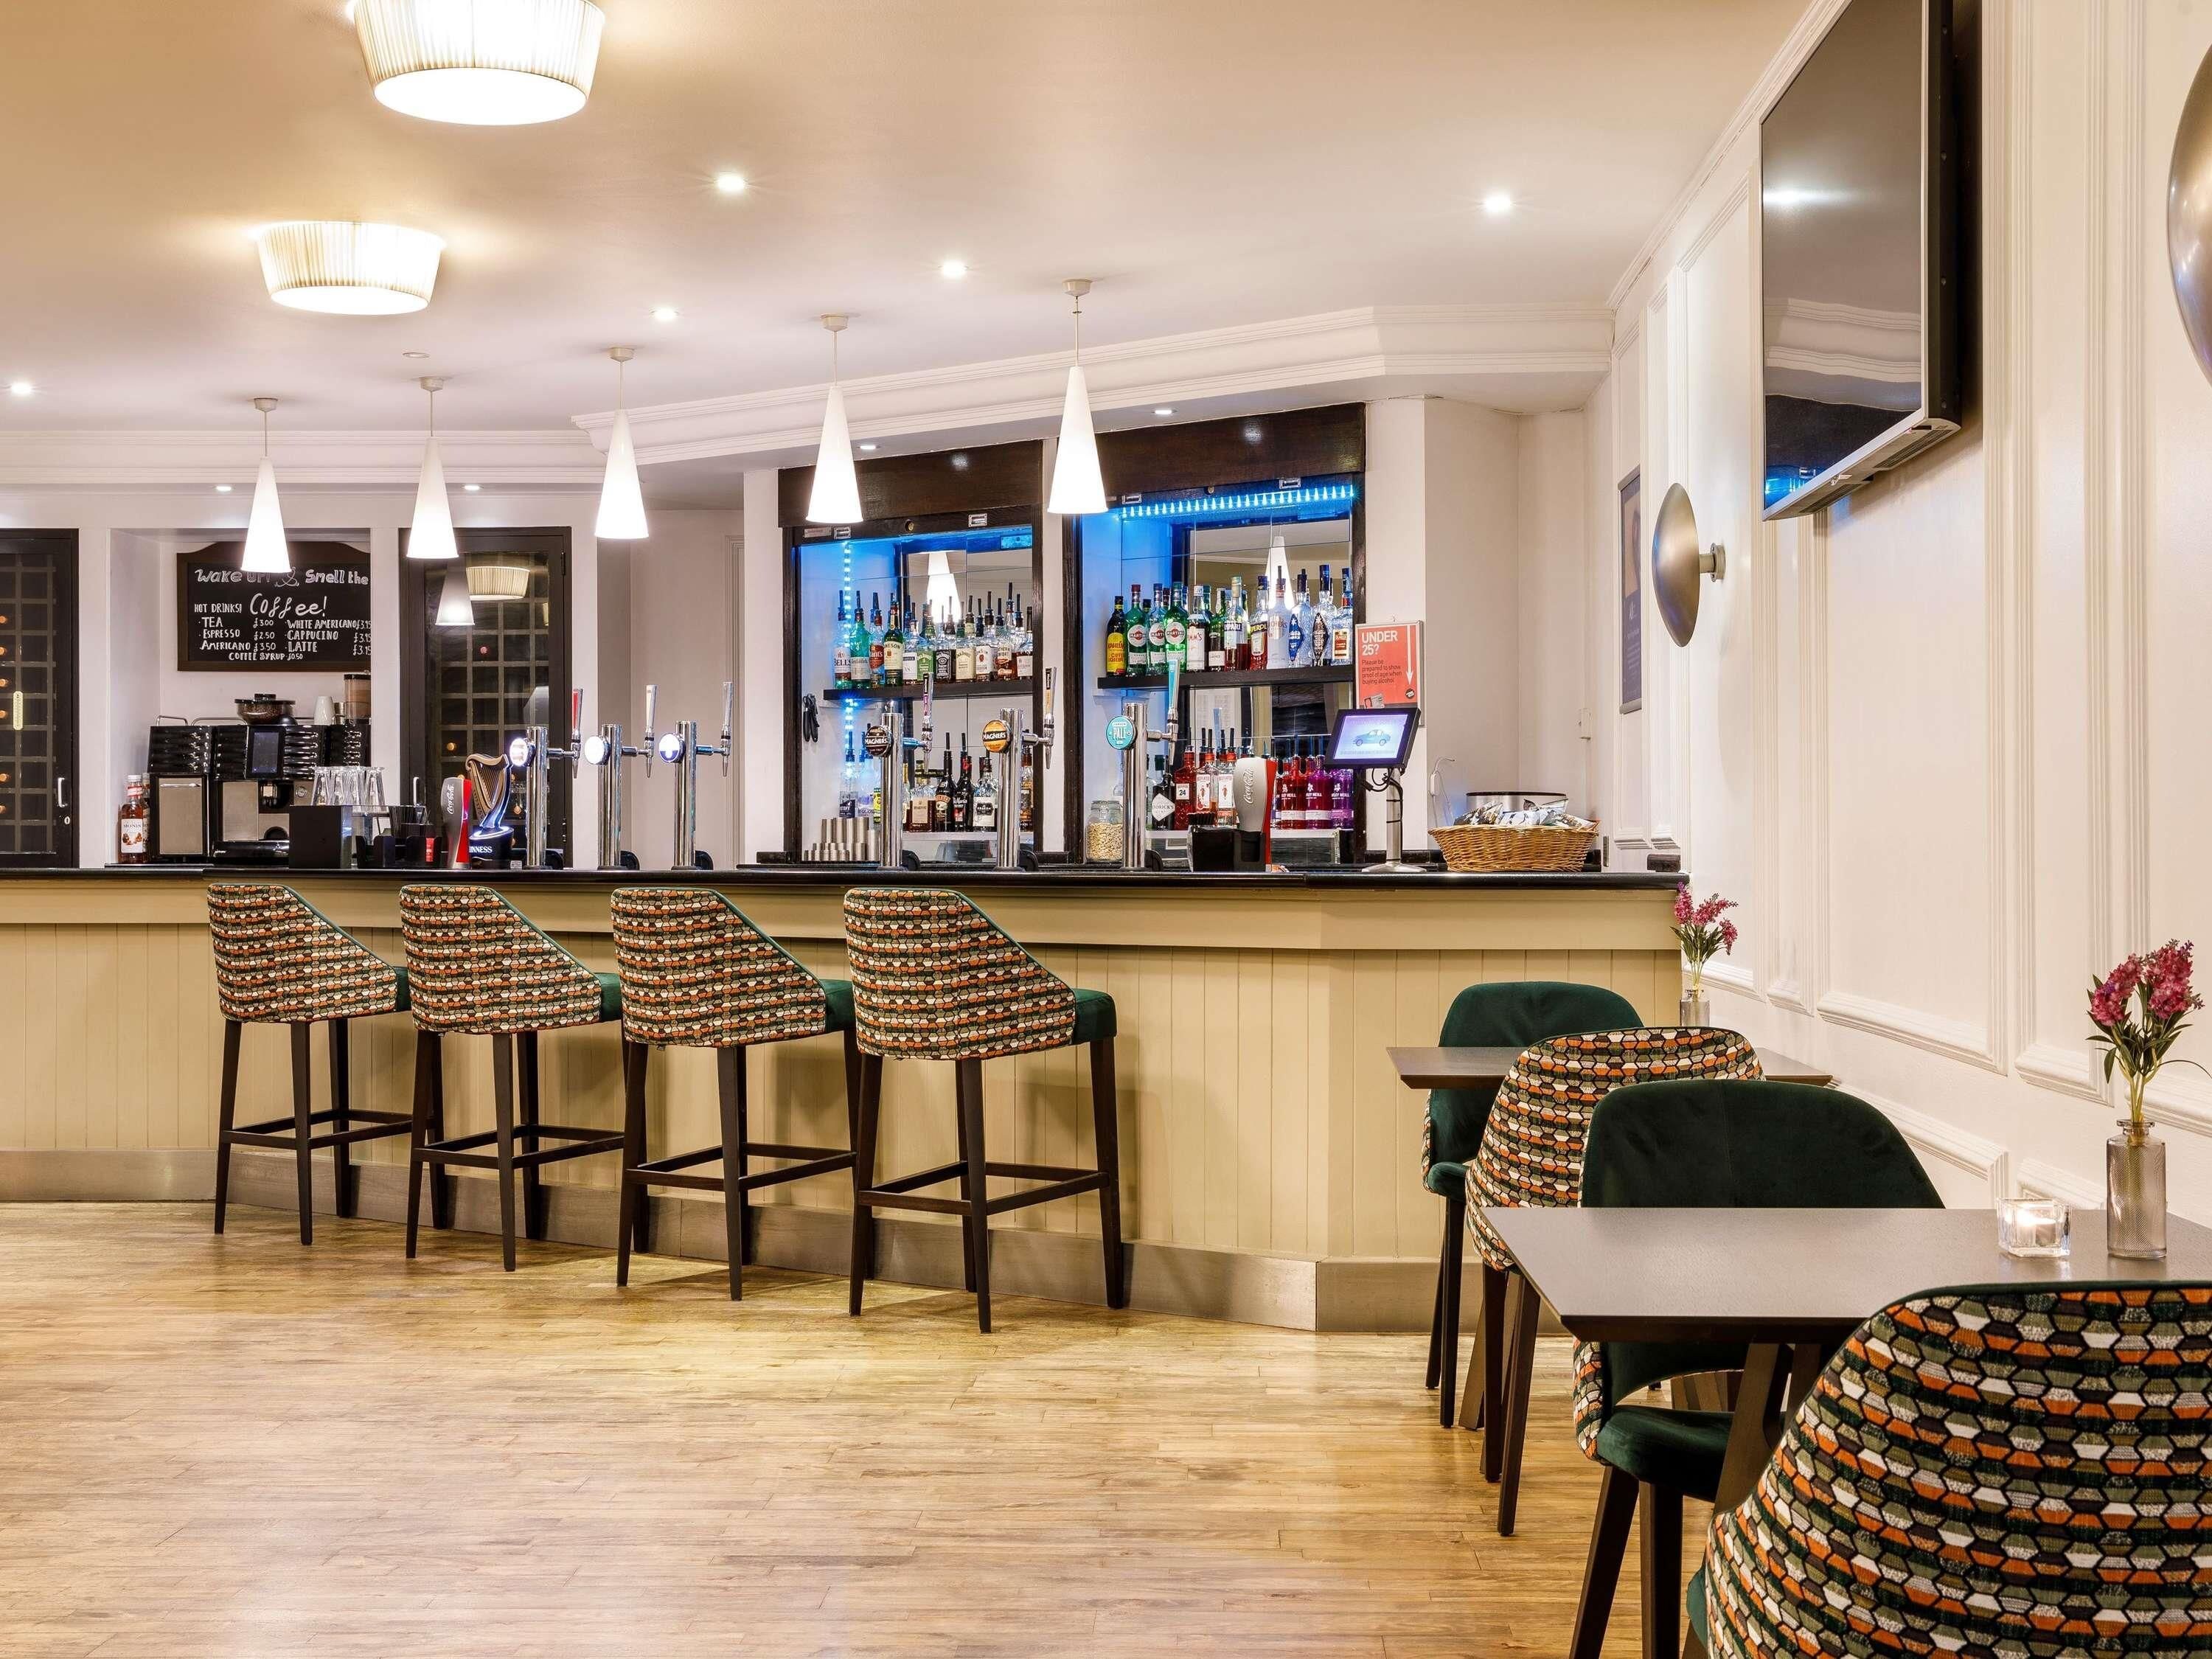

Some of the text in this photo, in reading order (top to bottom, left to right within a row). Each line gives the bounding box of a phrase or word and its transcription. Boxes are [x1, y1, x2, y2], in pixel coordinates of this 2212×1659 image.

[195, 569, 243, 582] Wake
[305, 569, 345, 584] Smell
[348, 571, 369, 585] the
[194, 603, 243, 613] HOT DRINKS!
[250, 593, 327, 619] Coffee!
[201, 616, 223, 627] TEA
[287, 619, 313, 629] WHITE
[314, 619, 356, 629] AMERICANO
[203, 629, 275, 641] ESPRESSO £2.50
[288, 630, 338, 640] CAPPUCINO
[1361, 630, 1399, 644] UNDER
[201, 640, 276, 653] AMERICANO £3.50
[288, 641, 318, 653] LATTE
[1362, 644, 1380, 655] 25?
[229, 653, 257, 661] COFFEE
[260, 653, 285, 661] SYRUP
